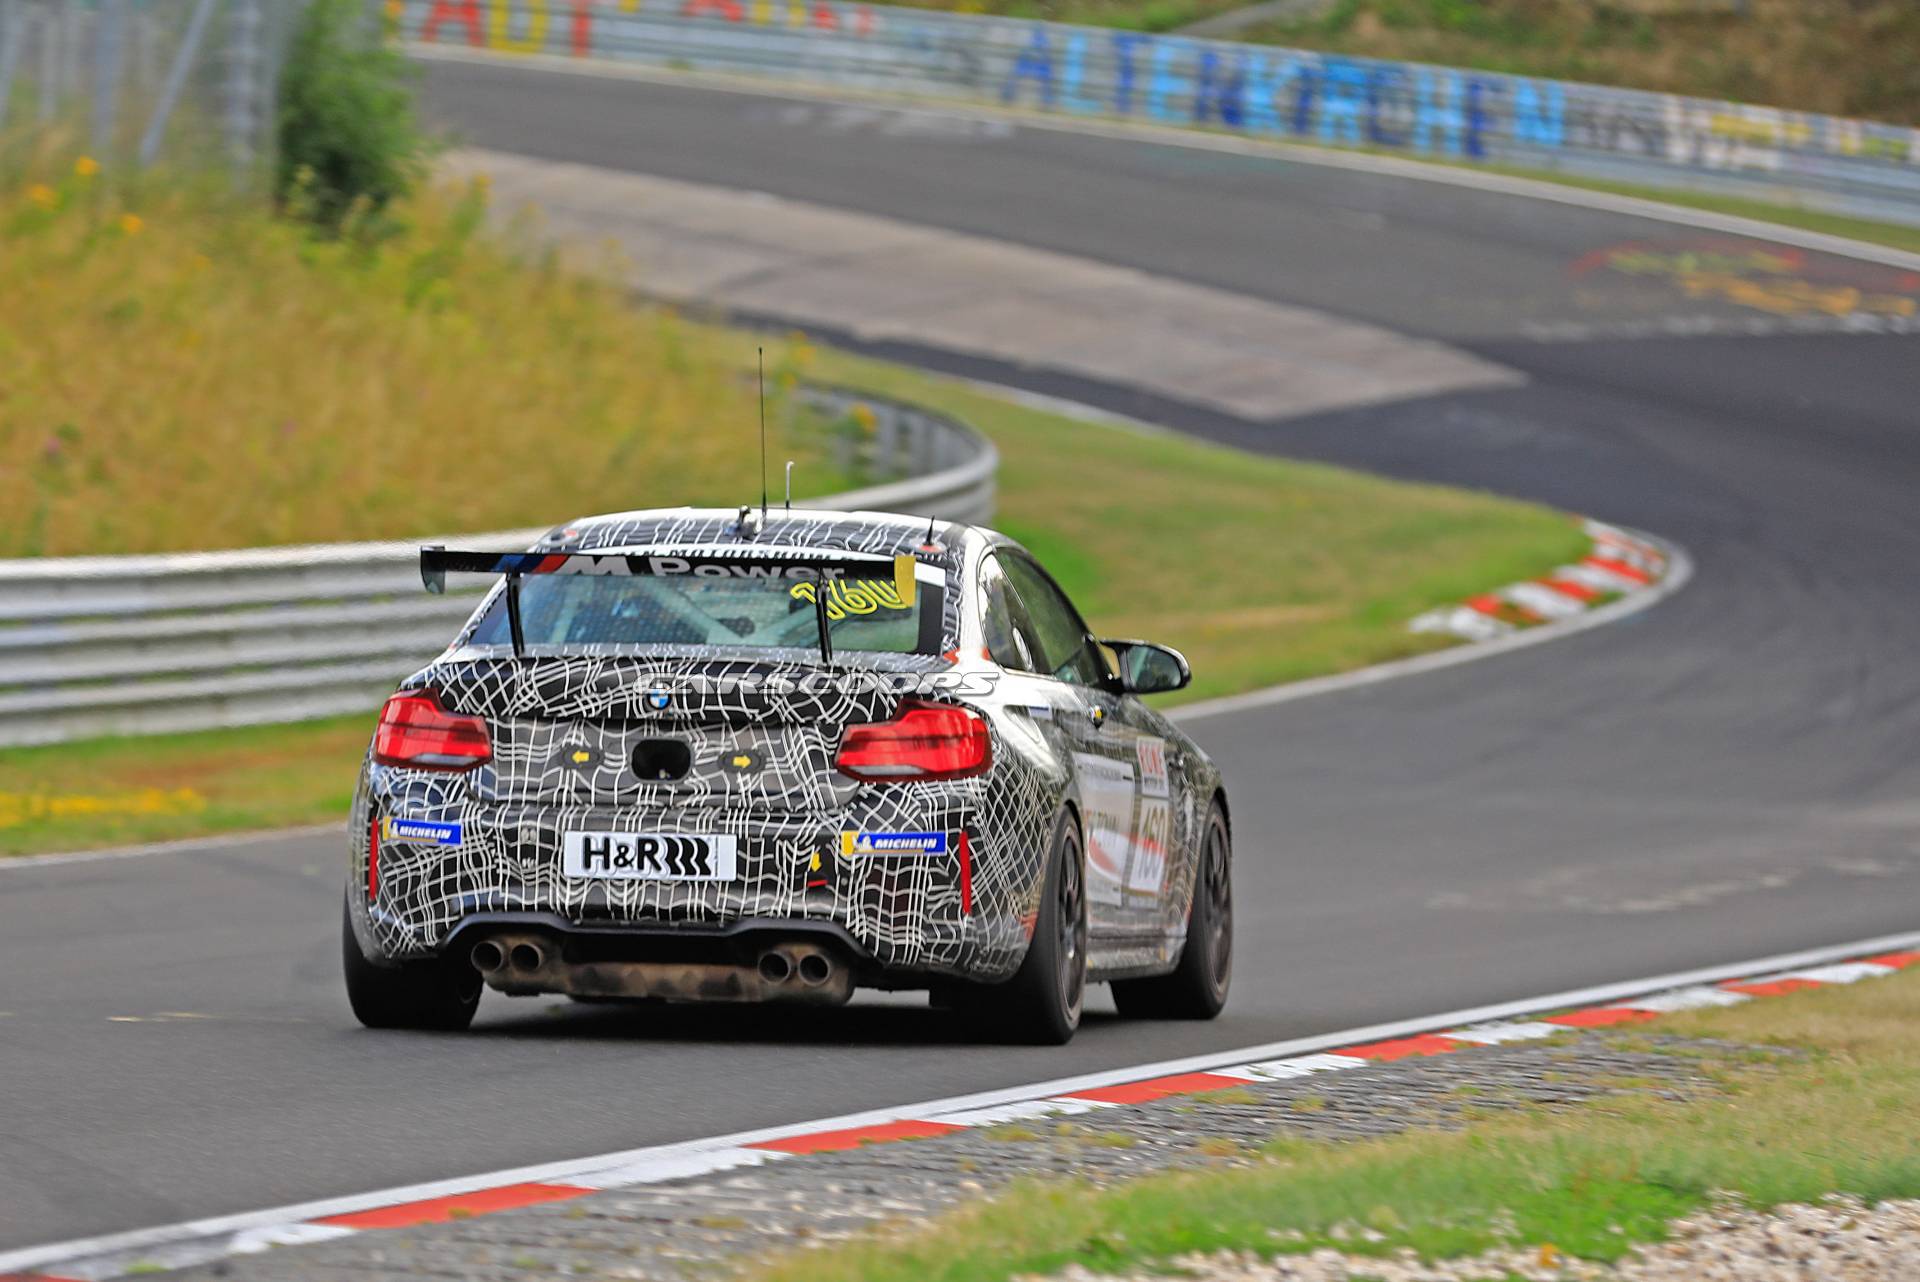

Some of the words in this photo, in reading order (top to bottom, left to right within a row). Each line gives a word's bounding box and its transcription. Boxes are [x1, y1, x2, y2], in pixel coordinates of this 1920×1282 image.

[1003, 20, 1565, 159] ALTENKIRCHEN
[649, 556, 846, 580] Power
[399, 825, 452, 840] MICHELIN
[874, 837, 937, 849] MICHELIN
[582, 835, 662, 872] H&R
